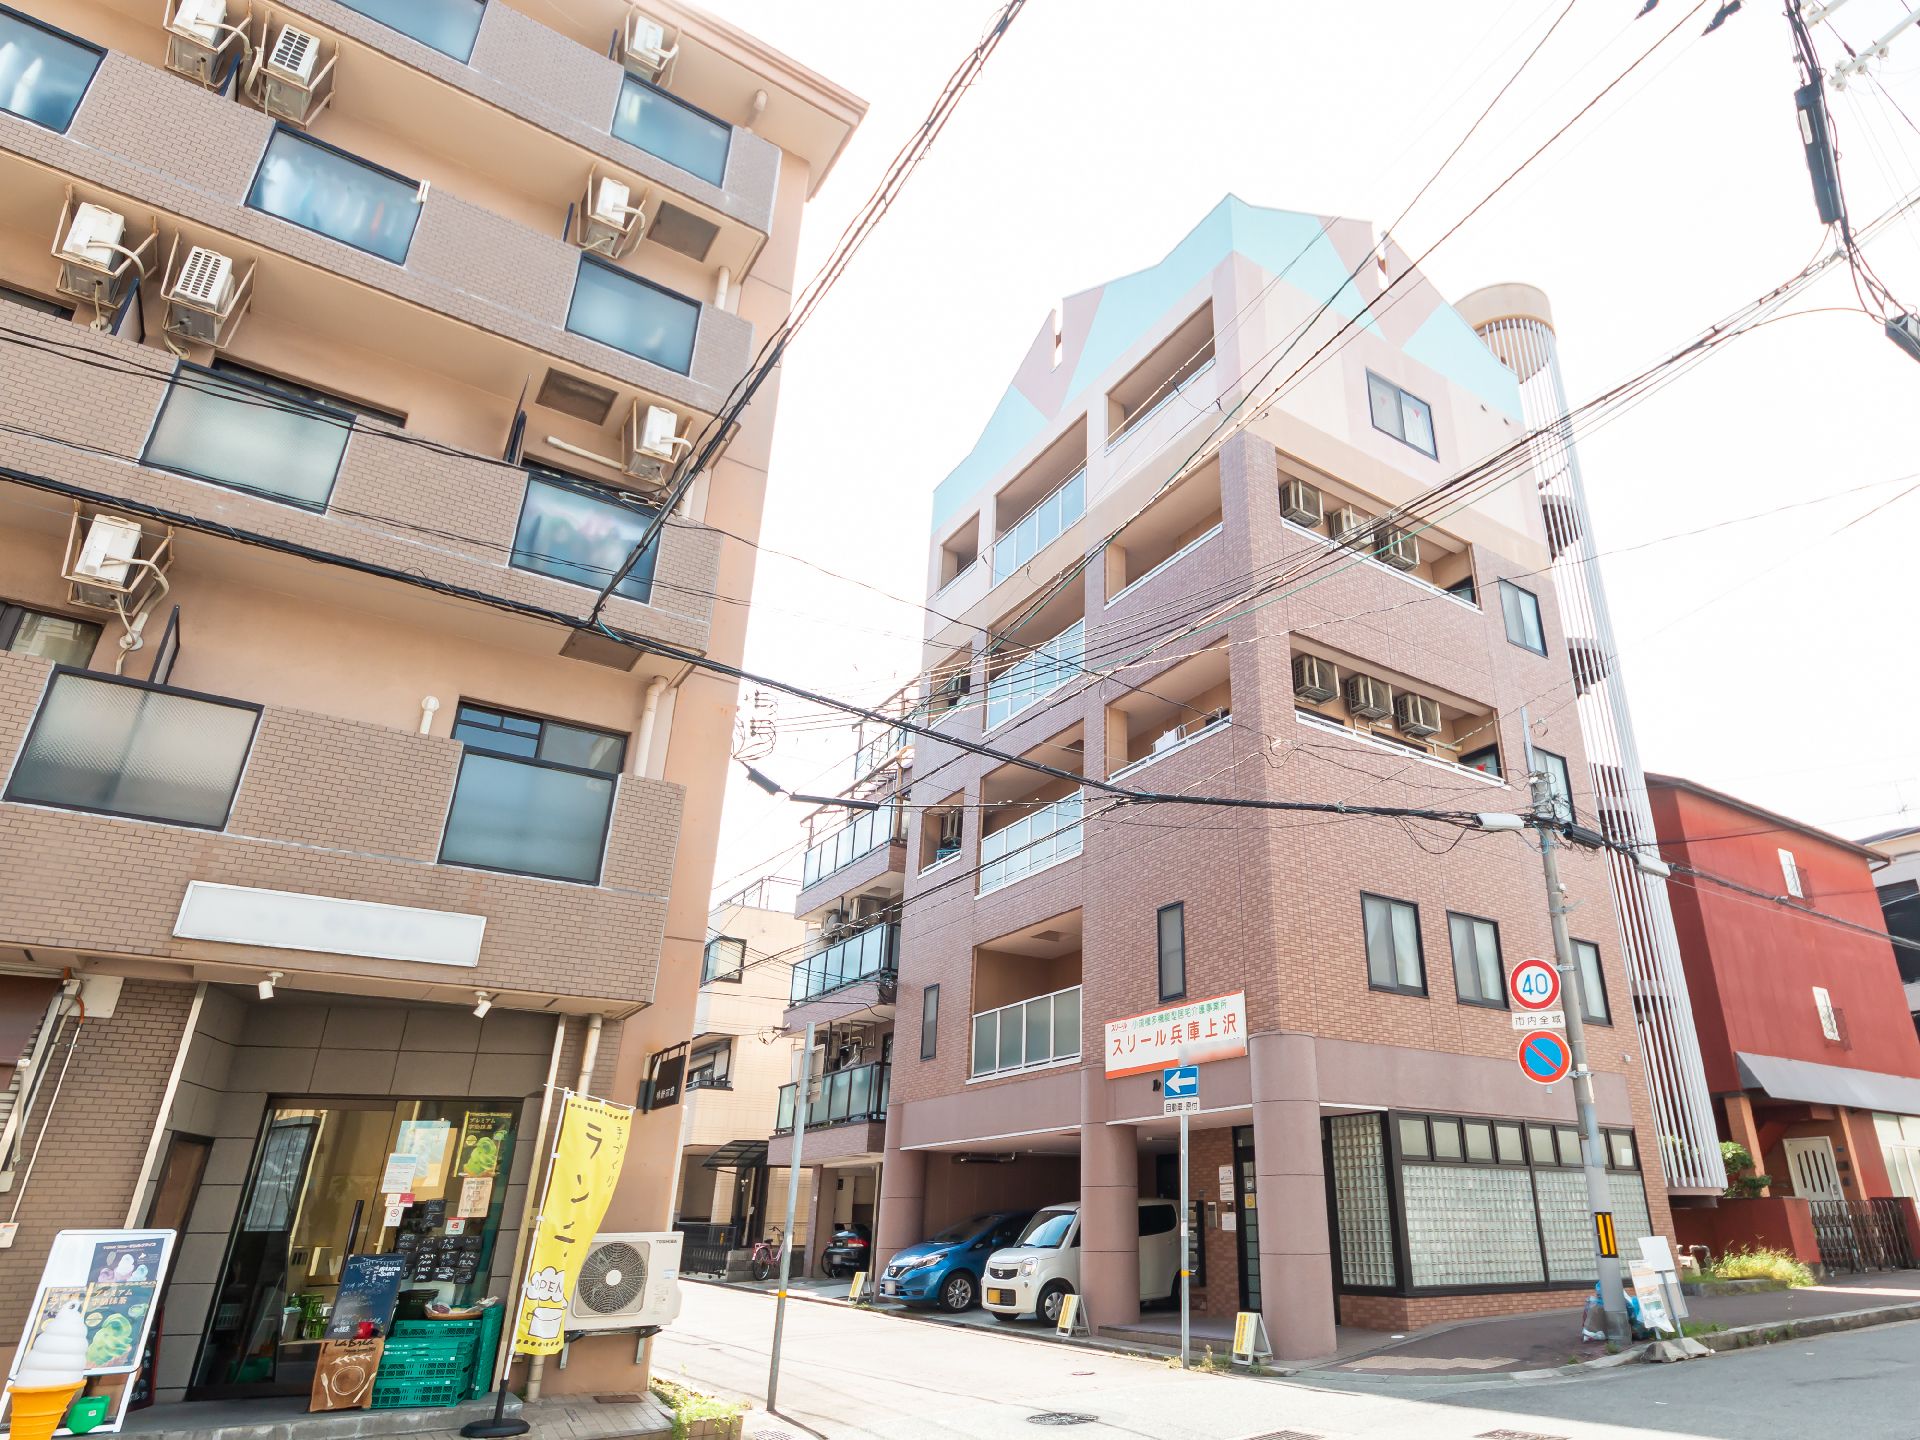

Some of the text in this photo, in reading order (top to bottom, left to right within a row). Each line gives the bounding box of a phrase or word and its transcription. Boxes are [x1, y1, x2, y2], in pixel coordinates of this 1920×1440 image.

[1522, 973, 1549, 995] 40
[1515, 1015, 1562, 1026] 市内全域
[1112, 1012, 1237, 1056] スリール兵庫上沢
[534, 1278, 563, 1296] OPEN
